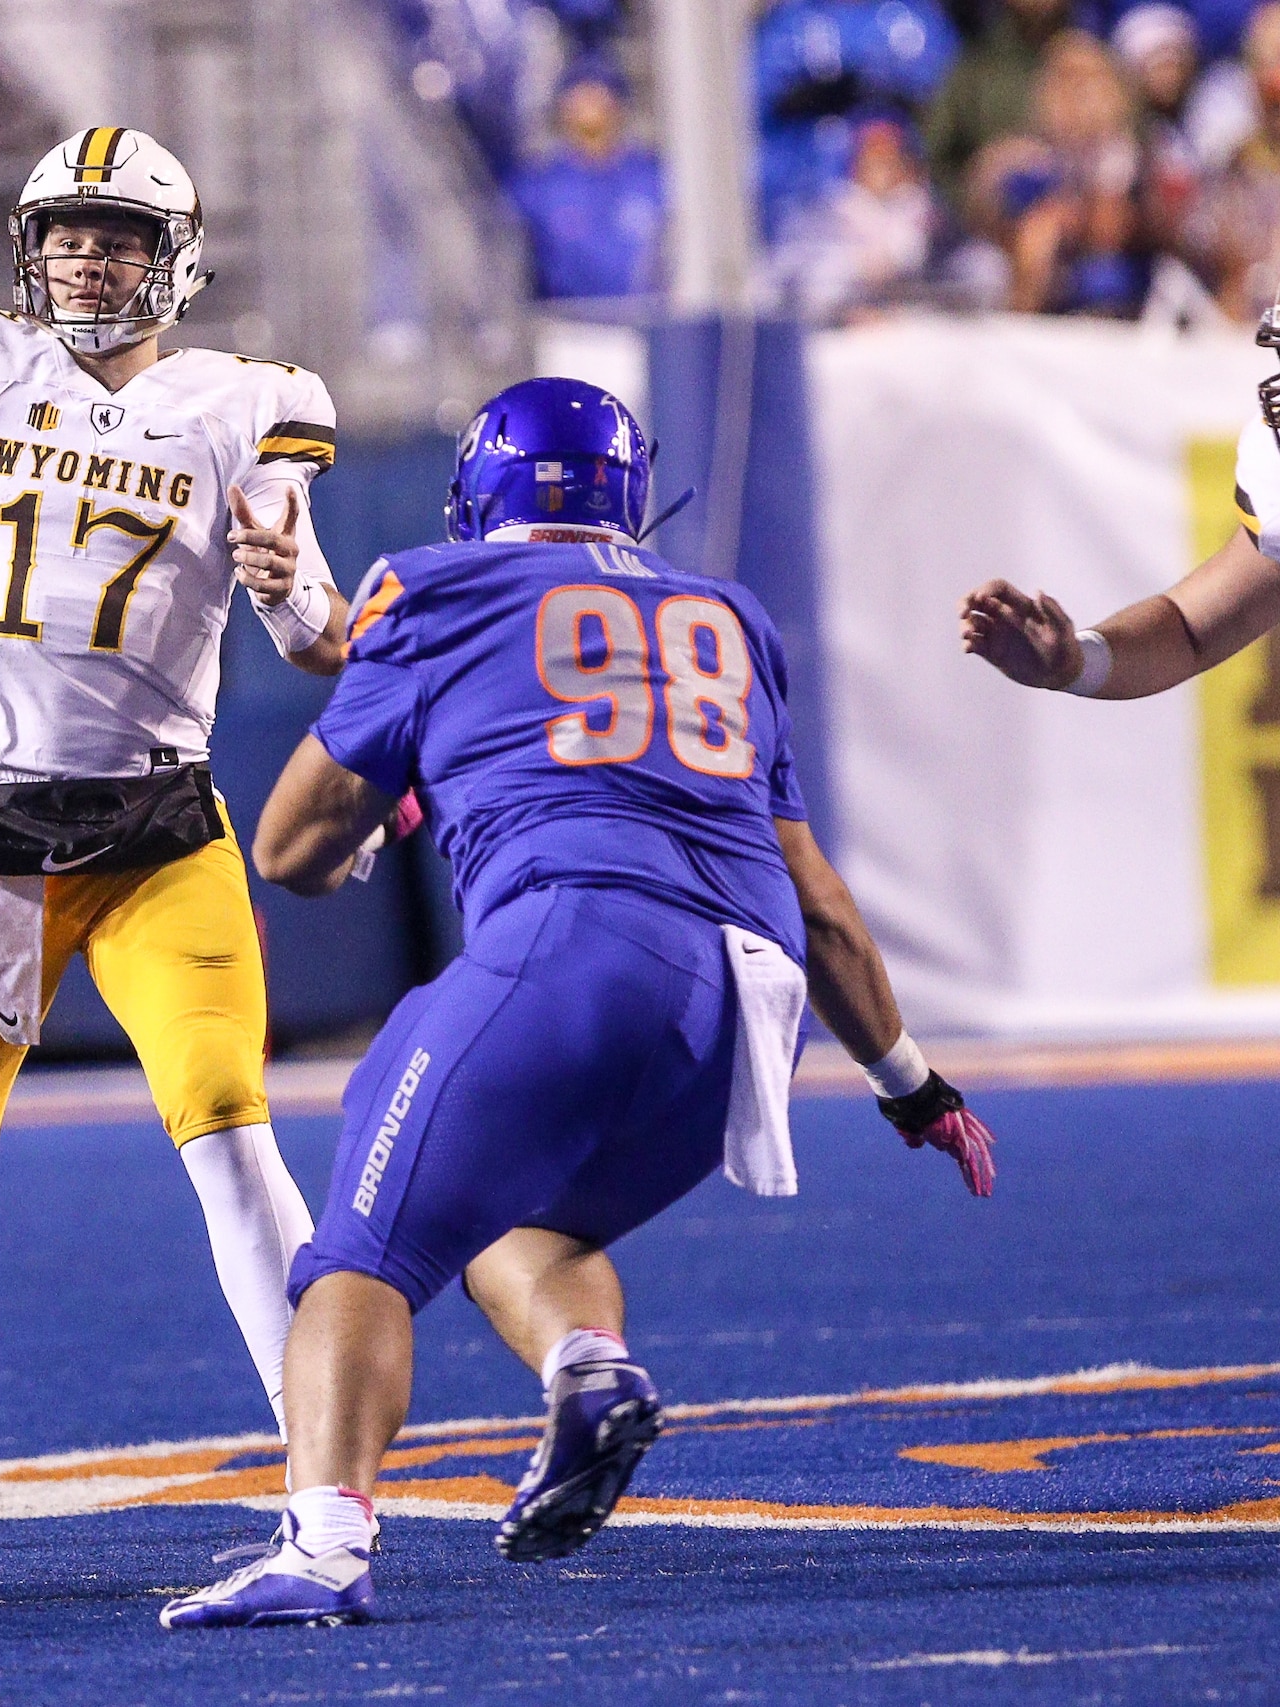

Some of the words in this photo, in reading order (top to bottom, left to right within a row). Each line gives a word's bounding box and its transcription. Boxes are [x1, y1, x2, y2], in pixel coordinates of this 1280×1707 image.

[162, 752, 170, 763] L
[535, 584, 755, 778] 98
[353, 1048, 431, 1217] BRONCOS
